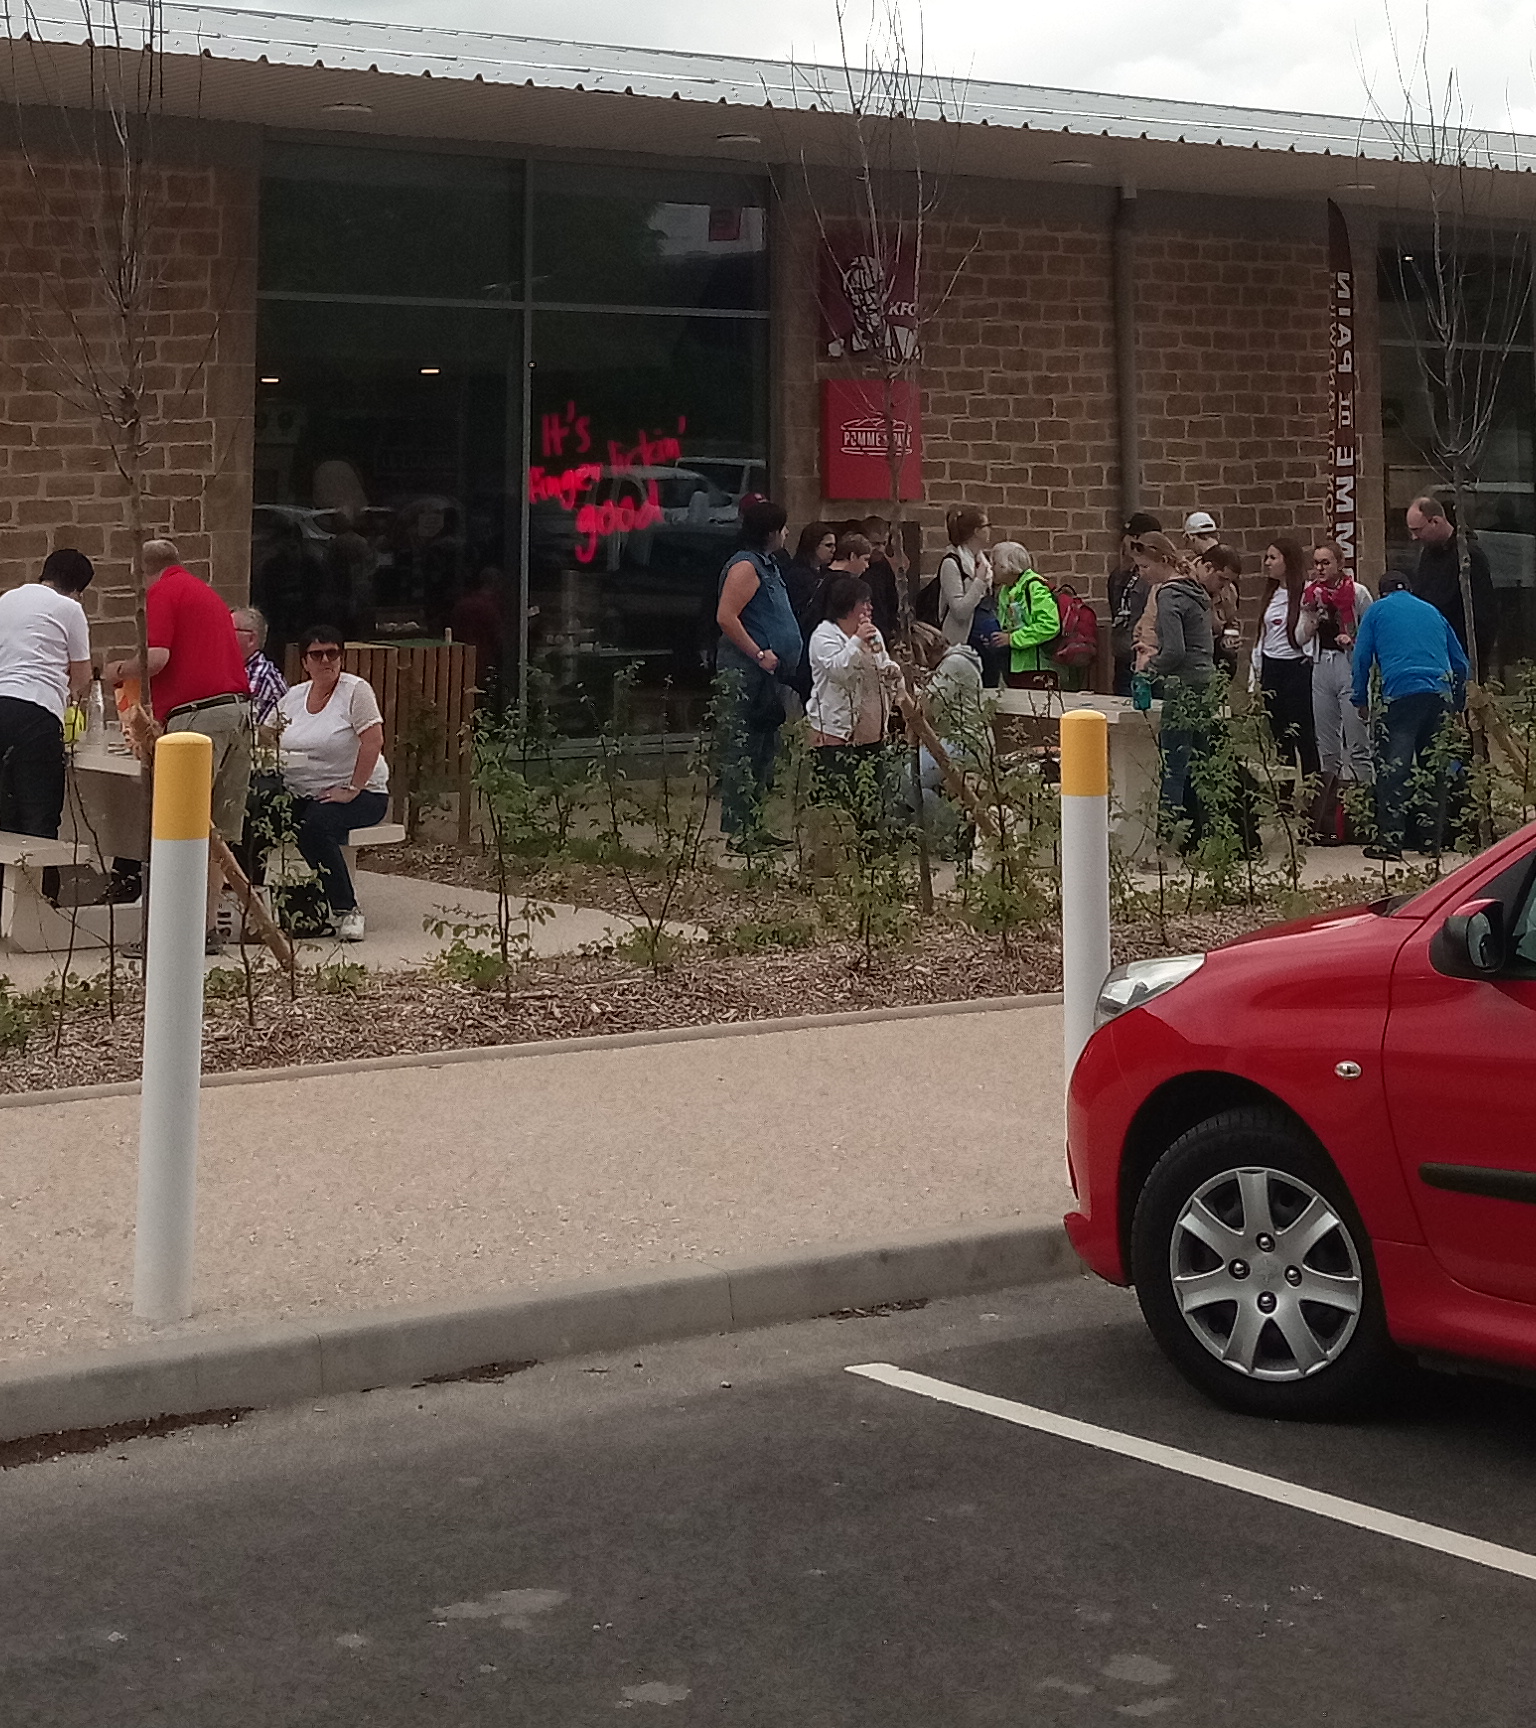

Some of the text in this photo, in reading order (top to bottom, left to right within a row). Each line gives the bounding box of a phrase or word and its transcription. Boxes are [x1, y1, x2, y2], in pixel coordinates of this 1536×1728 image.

[888, 302, 917, 317] KFC
[542, 400, 591, 456] It's
[575, 478, 663, 563] good
